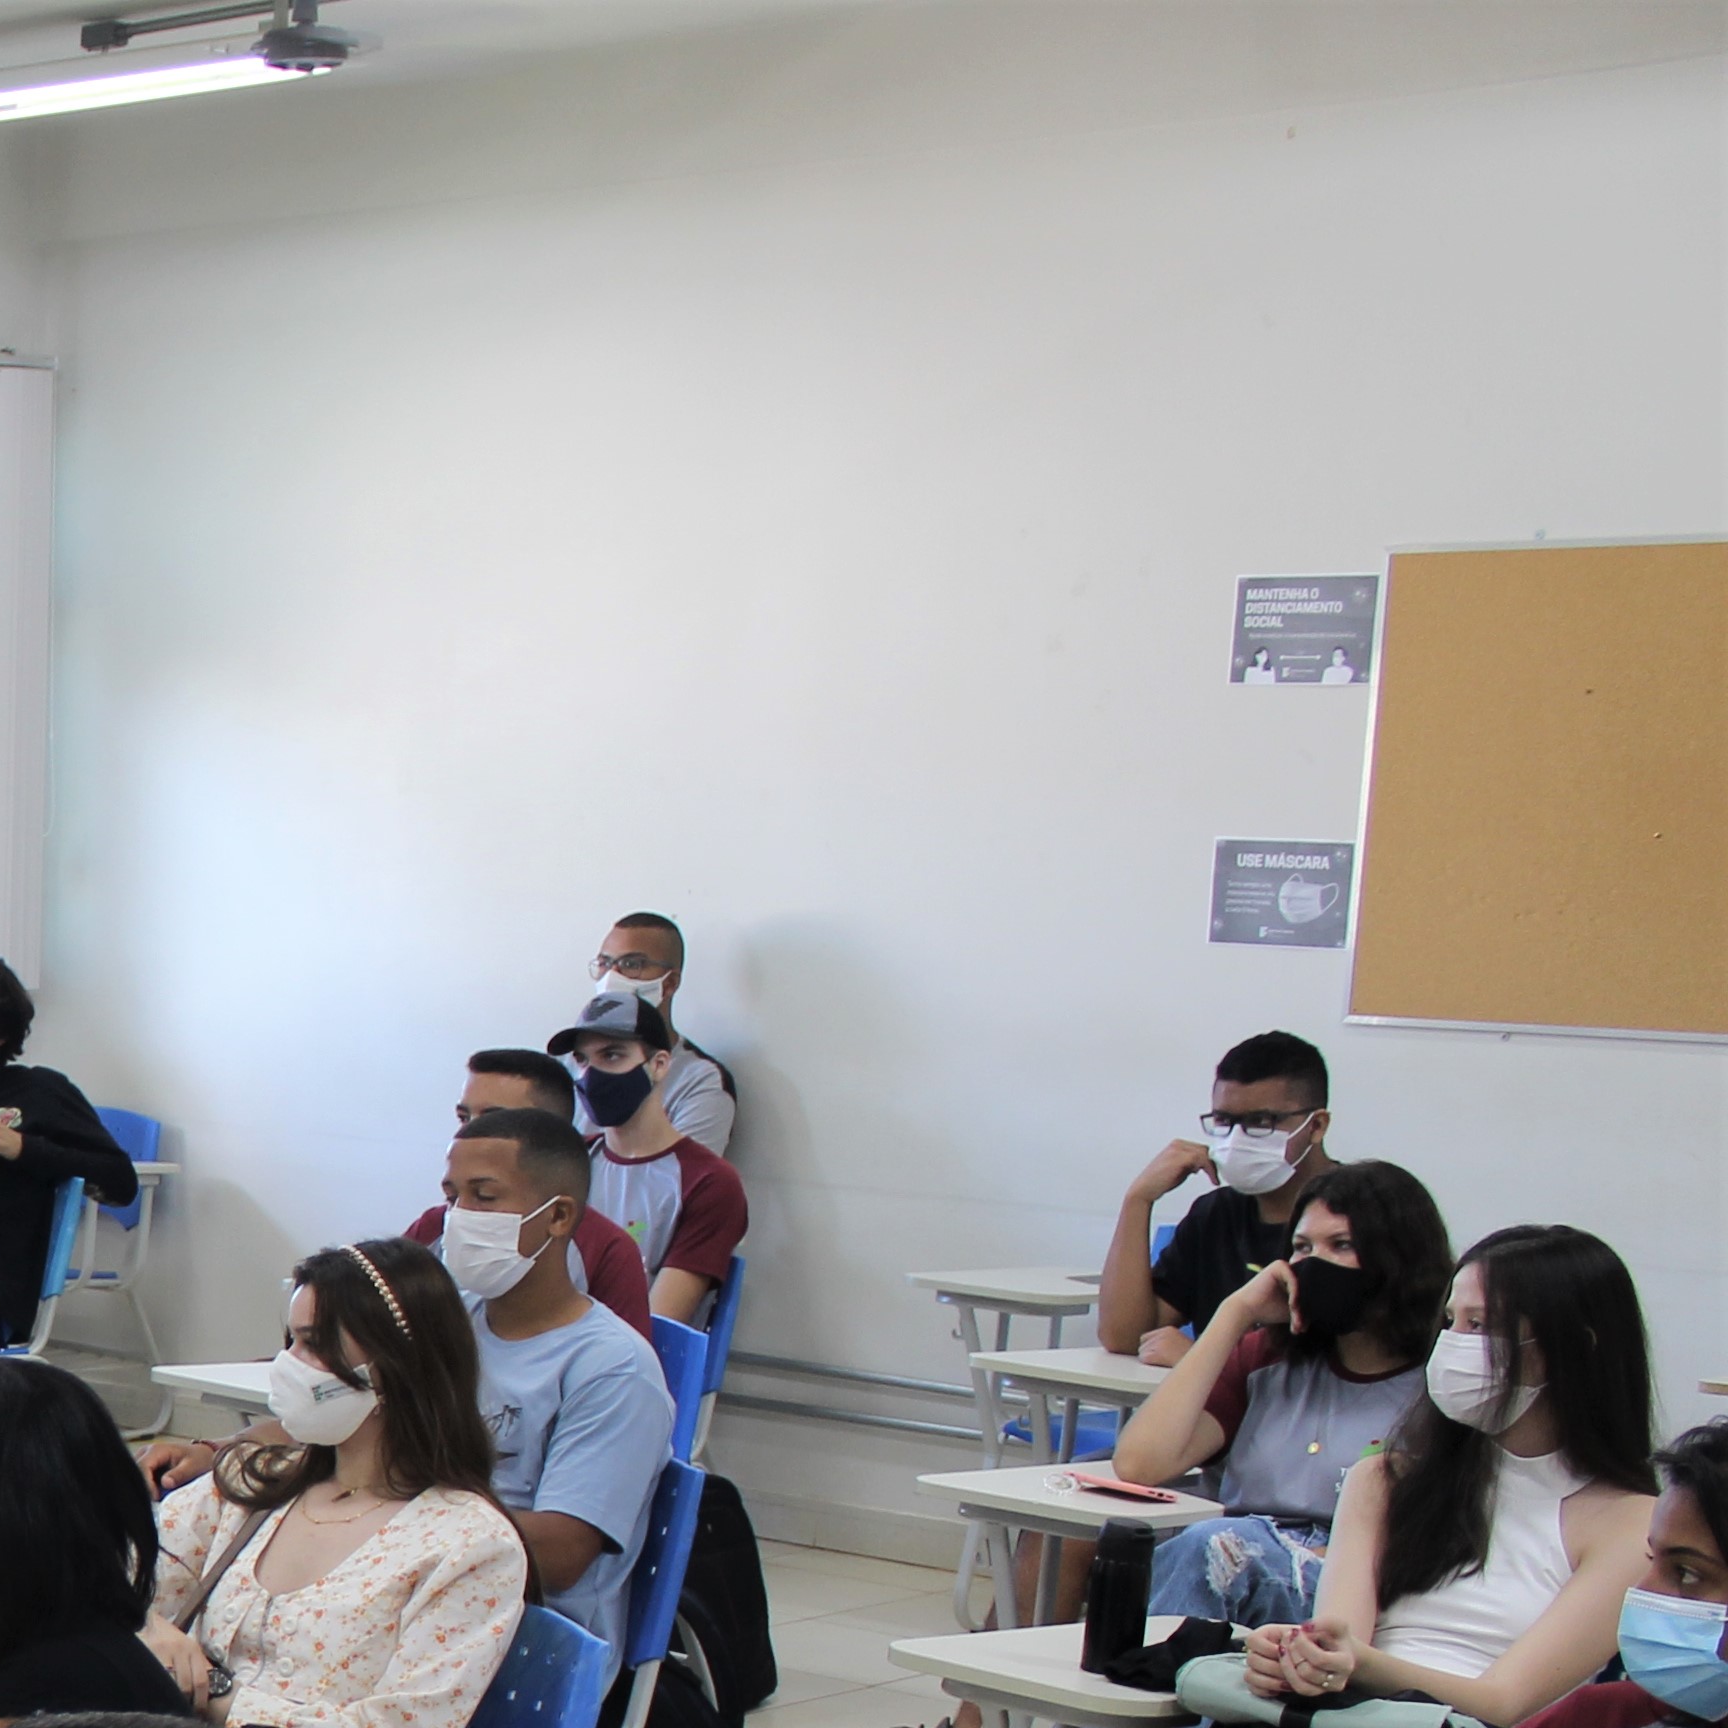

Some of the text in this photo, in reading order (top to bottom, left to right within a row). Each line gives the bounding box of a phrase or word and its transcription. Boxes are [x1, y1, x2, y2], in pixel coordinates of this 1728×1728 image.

[1246, 587, 1320, 601] MANTENHA O
[1244, 601, 1343, 615] DISTANCIAMENTO
[1243, 615, 1284, 628] SOCIAL
[1236, 852, 1330, 870] USE MÁSCARA
